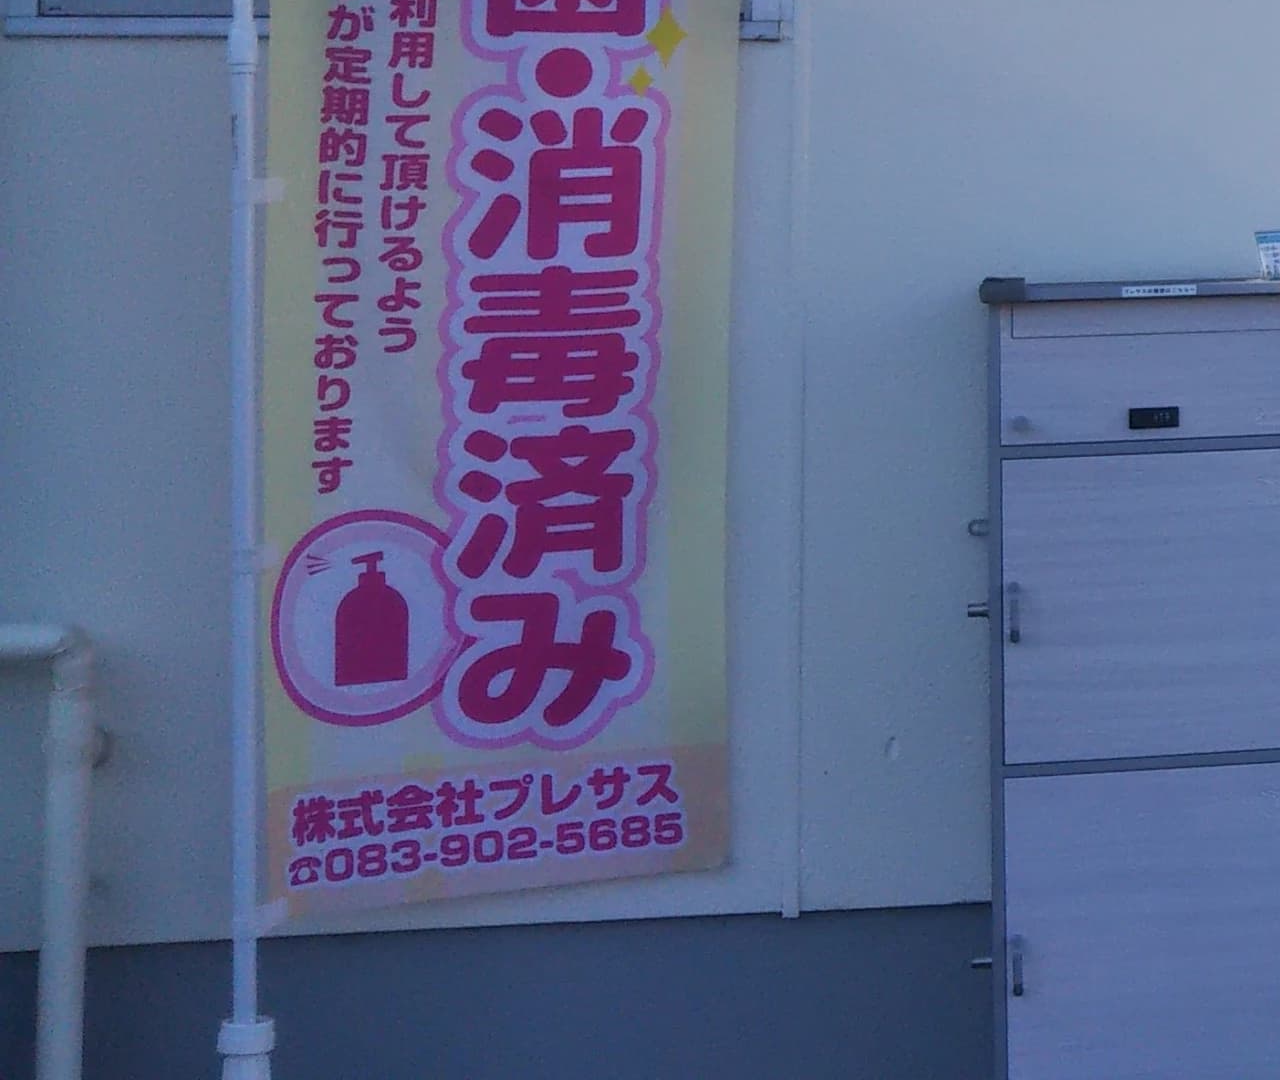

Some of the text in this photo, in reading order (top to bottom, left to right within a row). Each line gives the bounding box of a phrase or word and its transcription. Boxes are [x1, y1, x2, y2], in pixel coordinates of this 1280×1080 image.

[291, 761, 680, 845] 株式会社プレサス
[324, 813, 683, 883] 083-902-5685
